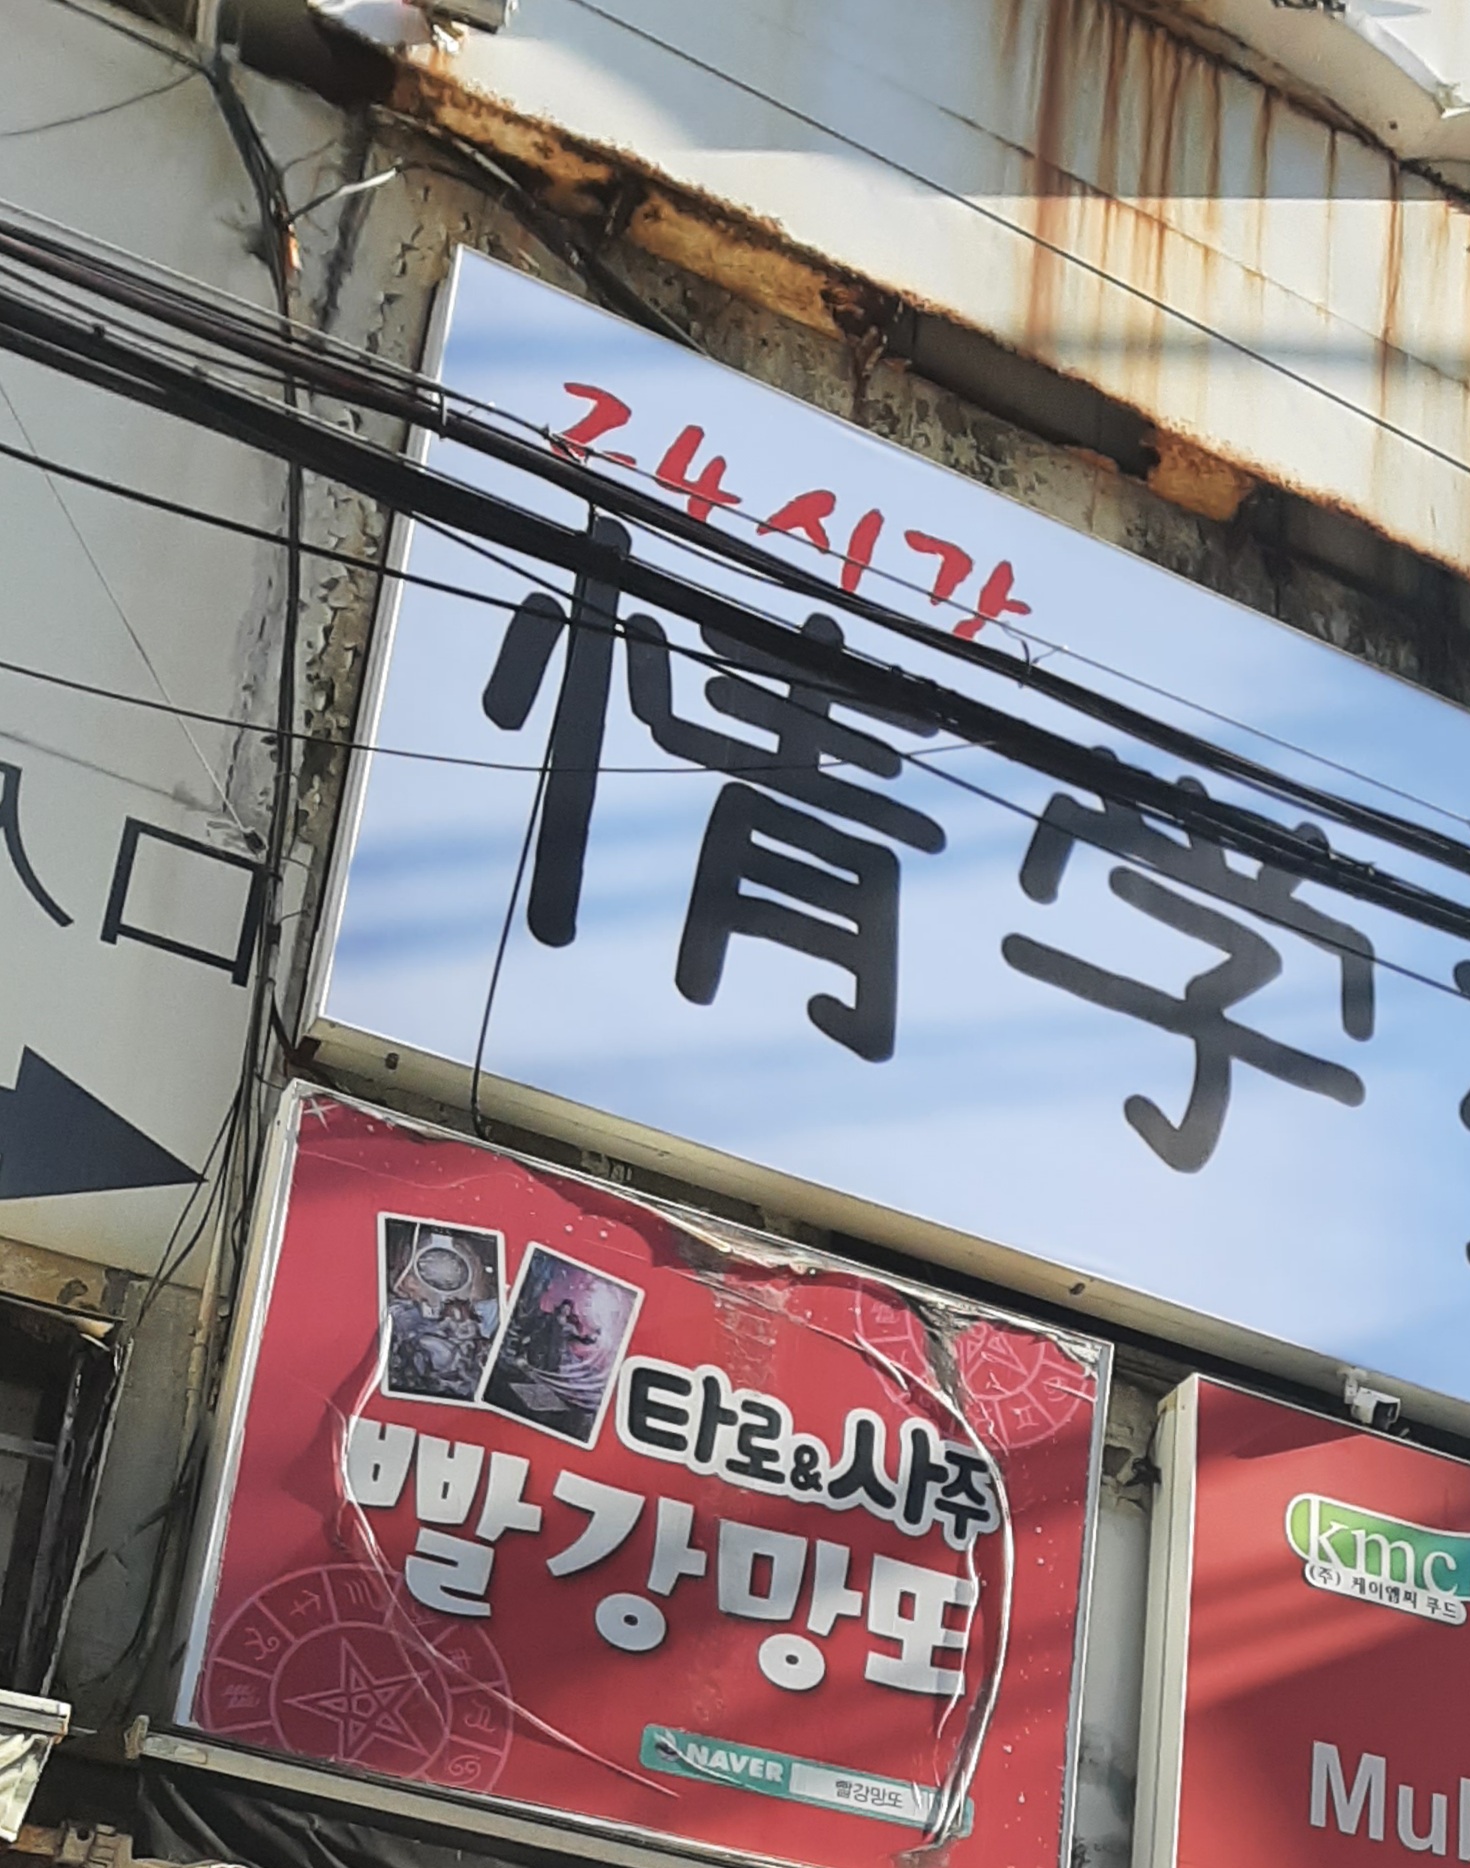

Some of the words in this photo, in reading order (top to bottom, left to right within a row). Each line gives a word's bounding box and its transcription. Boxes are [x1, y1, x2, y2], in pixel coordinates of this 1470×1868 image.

[622, 1361, 1000, 1546] 타로&사주
[343, 1414, 979, 1697] 빨강망또
[1308, 1497, 1458, 1596] kmc
[686, 1742, 784, 1784] NAVER
